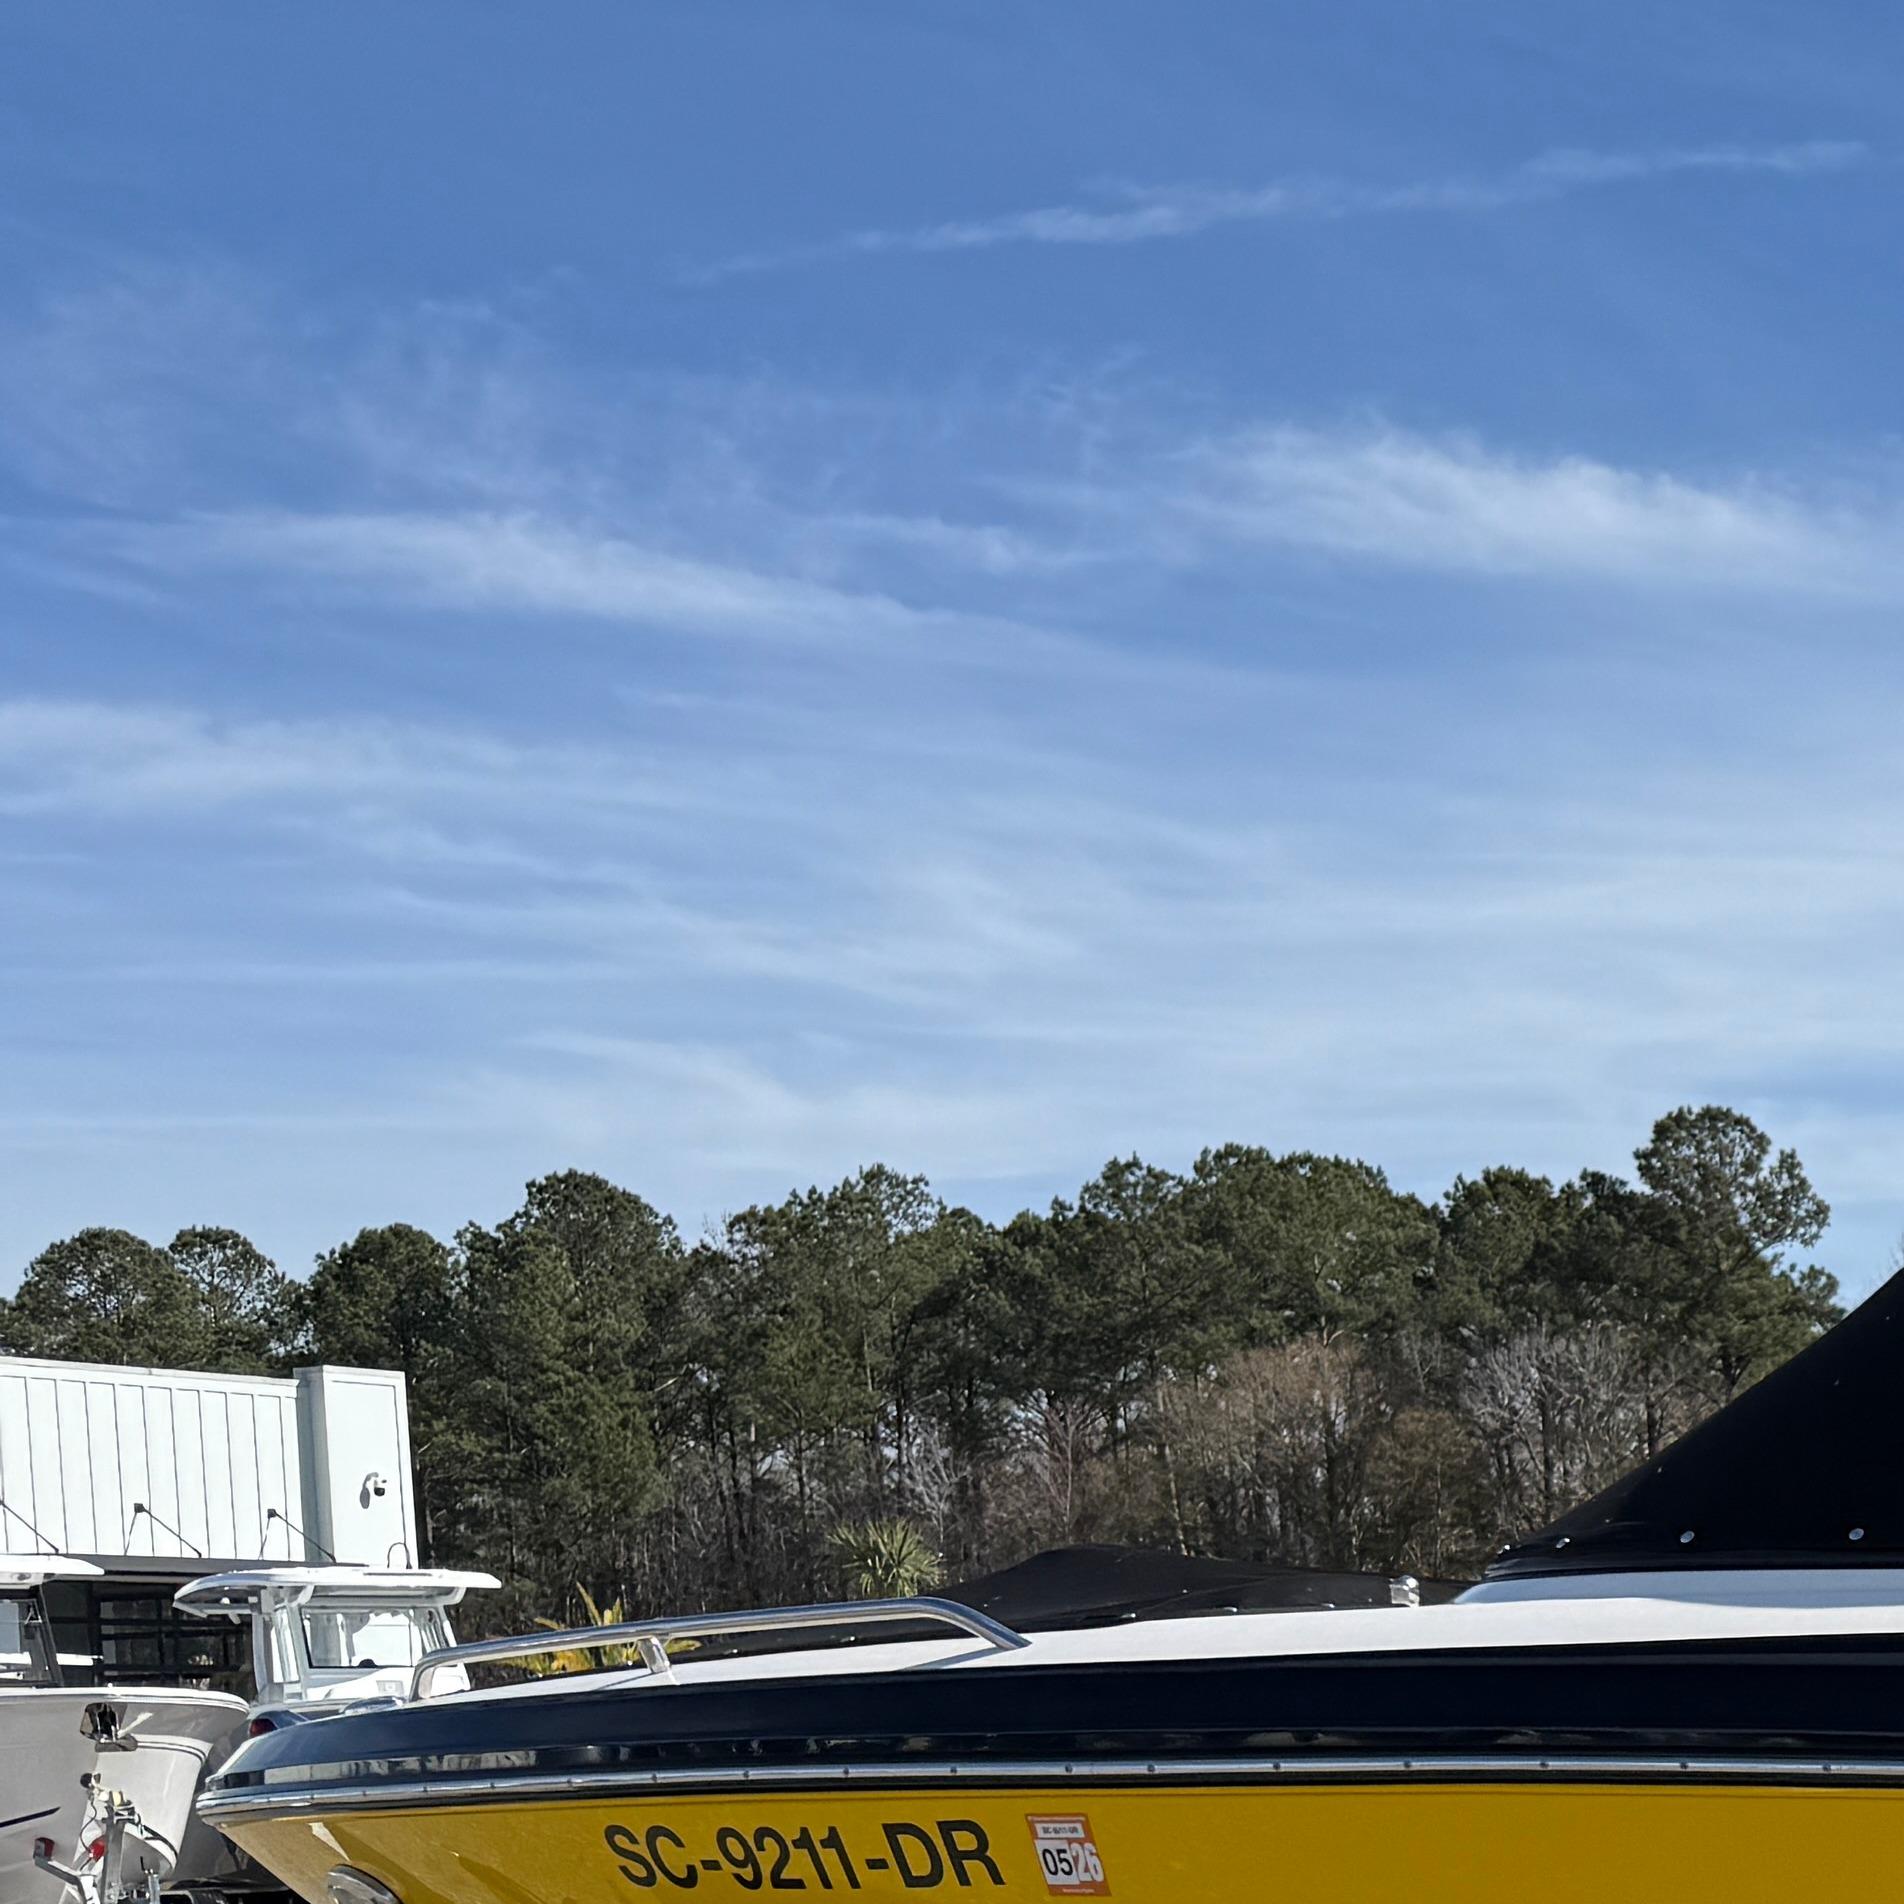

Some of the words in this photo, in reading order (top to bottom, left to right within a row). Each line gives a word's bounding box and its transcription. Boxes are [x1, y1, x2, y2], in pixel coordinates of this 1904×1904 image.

[604, 1819, 1006, 1891] SC-9211-DR
[1042, 1848, 1073, 1876] 05
[1070, 1842, 1104, 1882] 26
